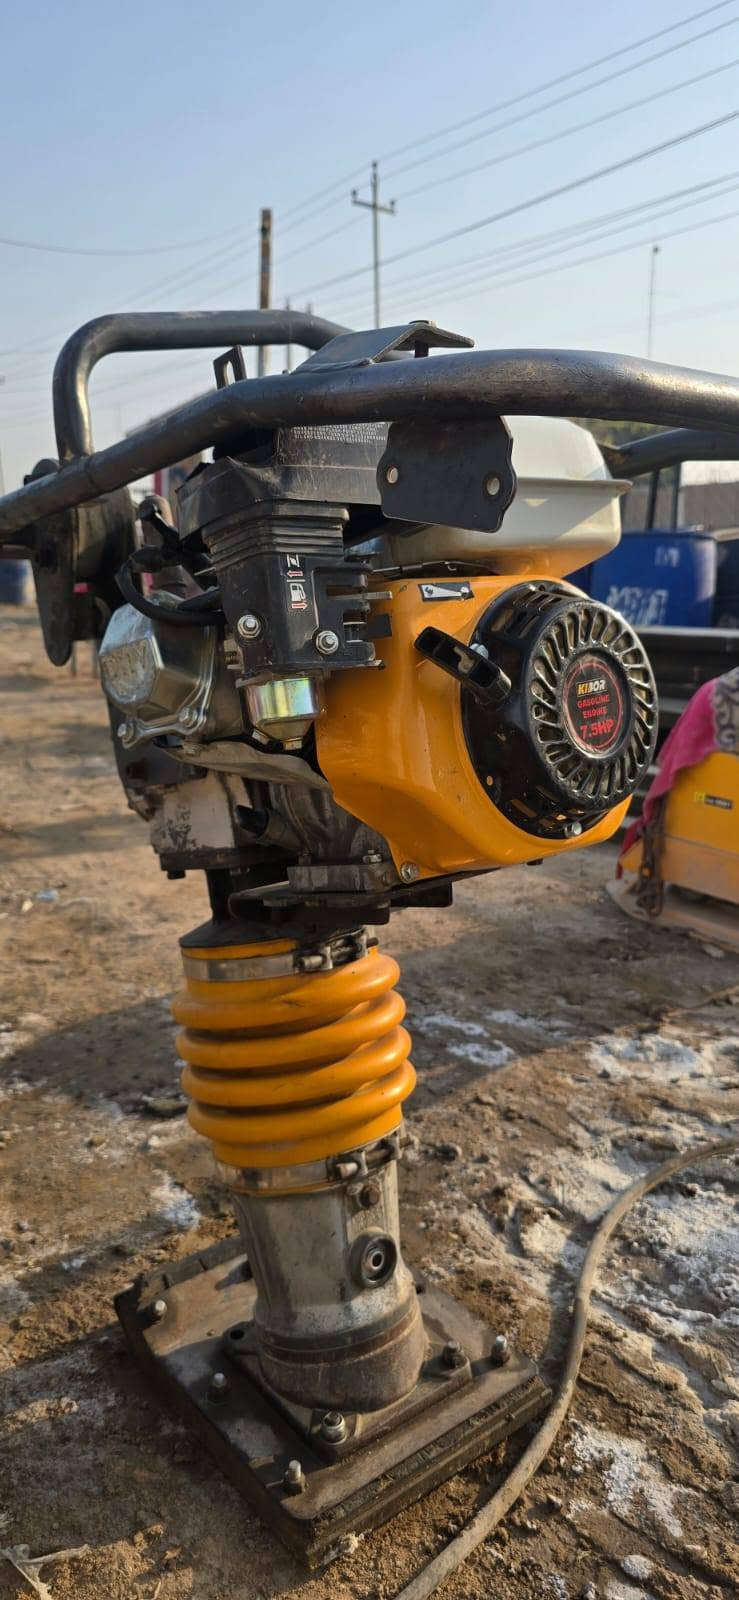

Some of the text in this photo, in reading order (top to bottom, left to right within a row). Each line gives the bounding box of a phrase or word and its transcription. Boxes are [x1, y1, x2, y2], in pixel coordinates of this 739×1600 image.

[578, 680, 606, 695] KIBOR
[578, 694, 610, 708] GASOLINE
[583, 706, 608, 719] ENGINE
[580, 719, 615, 738] 7.5HP
